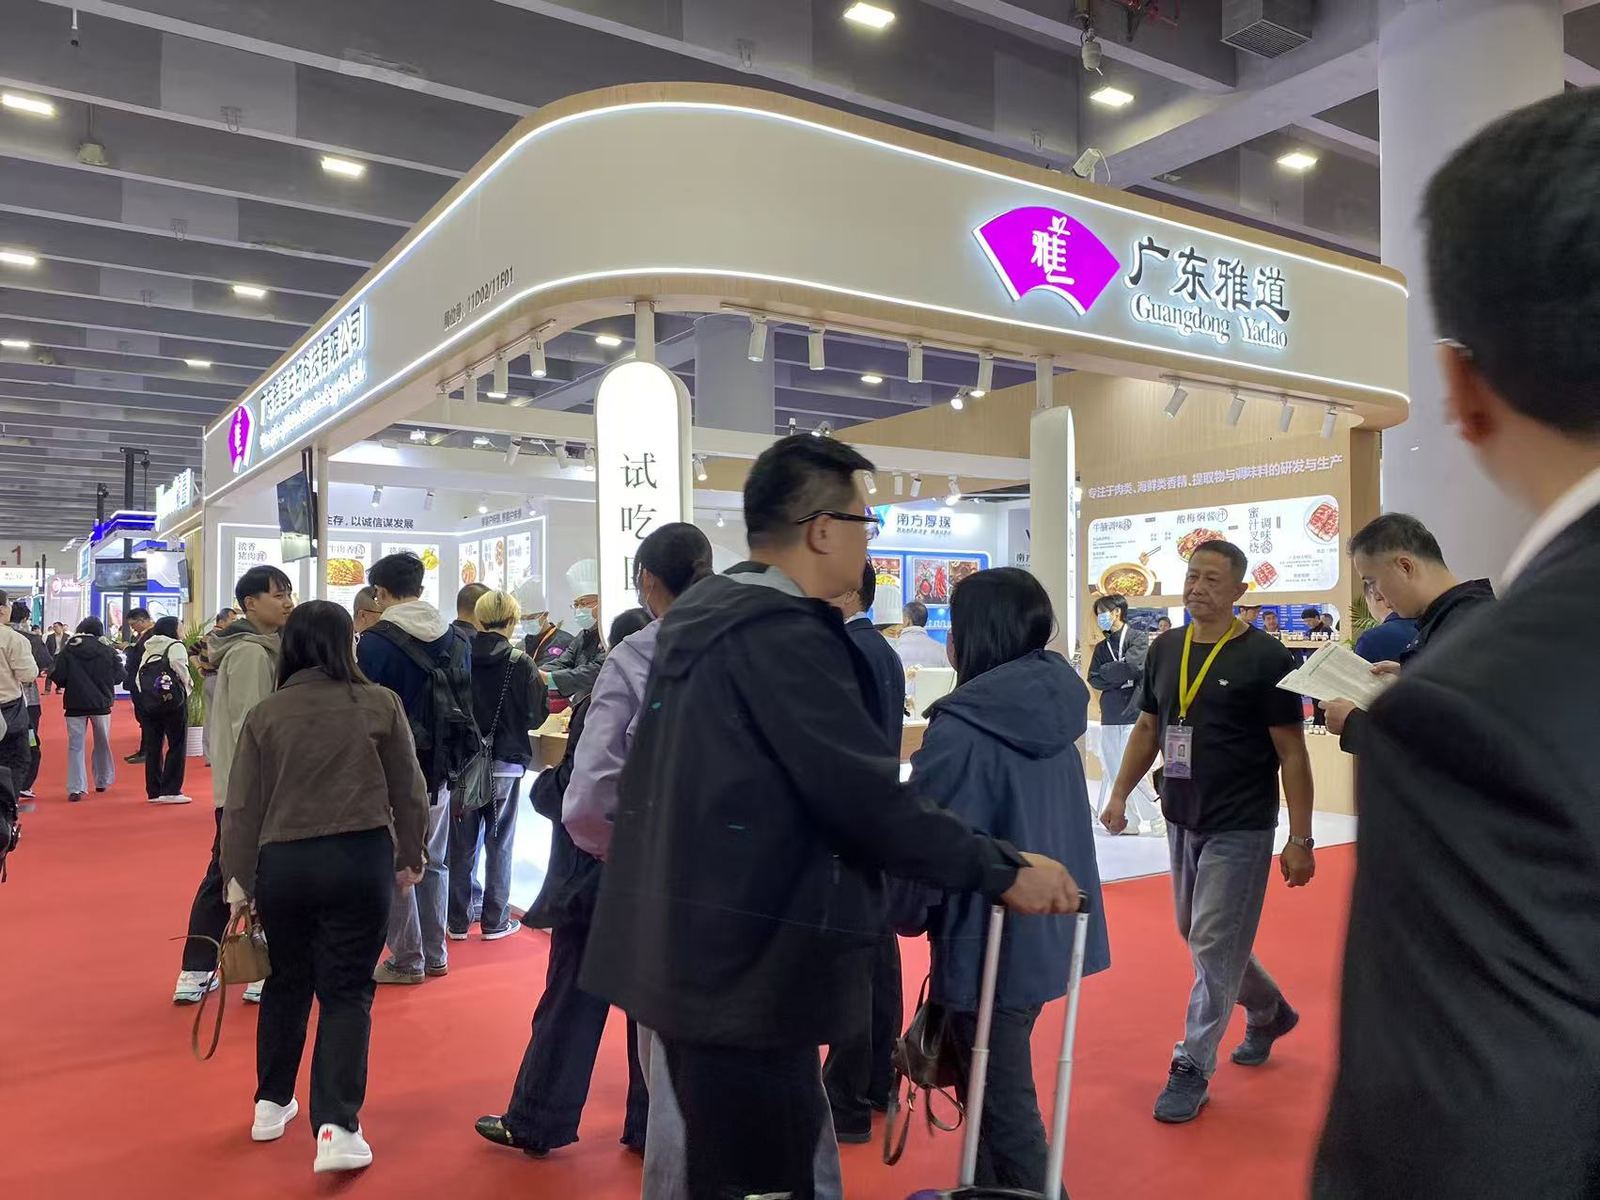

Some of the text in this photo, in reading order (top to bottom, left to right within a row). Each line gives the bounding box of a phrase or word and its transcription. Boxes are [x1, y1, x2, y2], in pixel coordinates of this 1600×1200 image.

[1126, 236, 1291, 323] 广东雅道
[1133, 293, 1289, 349] Guangdong Yadao
